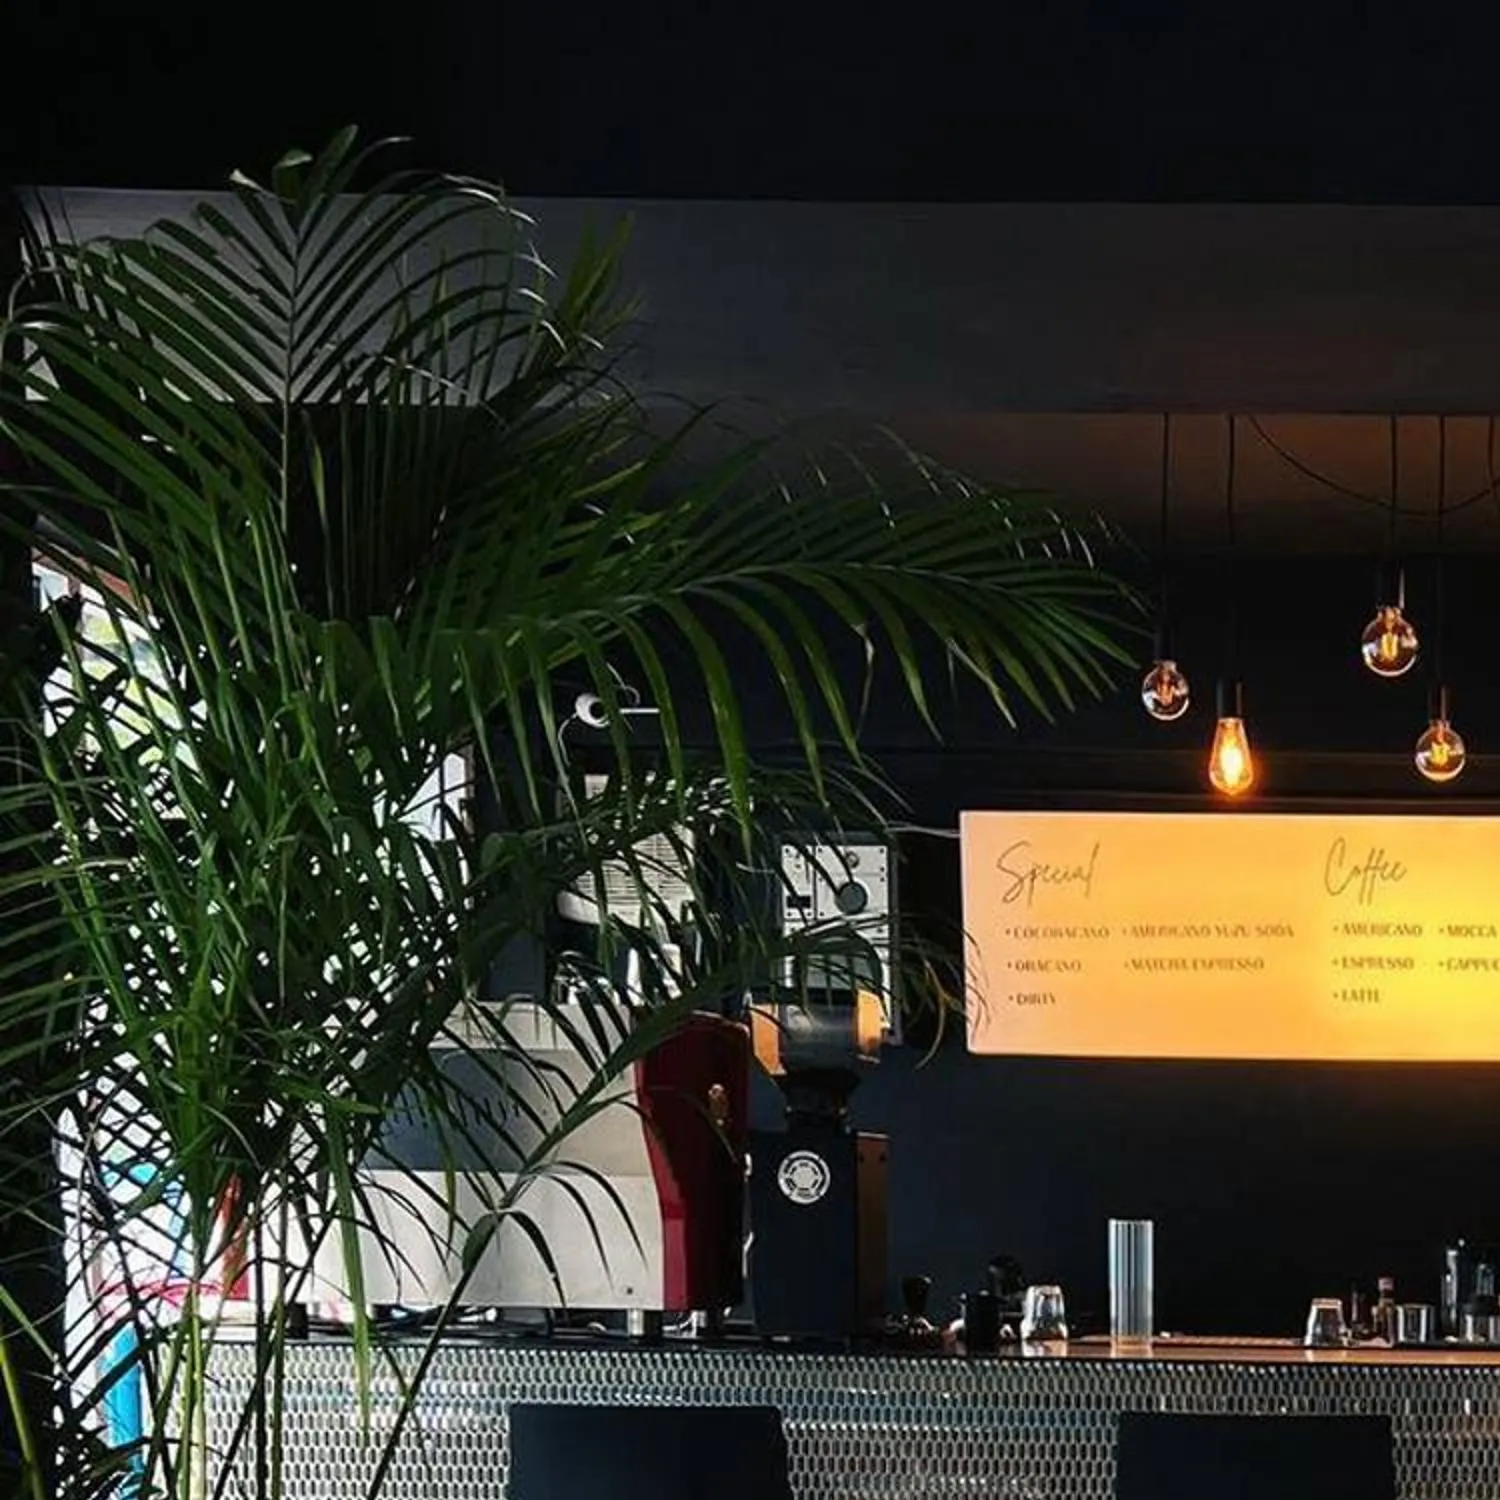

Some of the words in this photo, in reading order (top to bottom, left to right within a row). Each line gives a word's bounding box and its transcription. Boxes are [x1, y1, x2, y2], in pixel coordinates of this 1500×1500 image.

[996, 840, 1101, 906] Special
[1324, 837, 1408, 904] Coffee
[1130, 924, 1211, 938] AMERICANO
[1255, 924, 1295, 938] SODA
[1341, 923, 1423, 938] AMERICANO
[1446, 924, 1498, 939] MOCCA
[1341, 956, 1415, 971] ESPRESSO
[1015, 991, 1057, 1006] DIRTY
[1341, 988, 1380, 1003] LATTE
